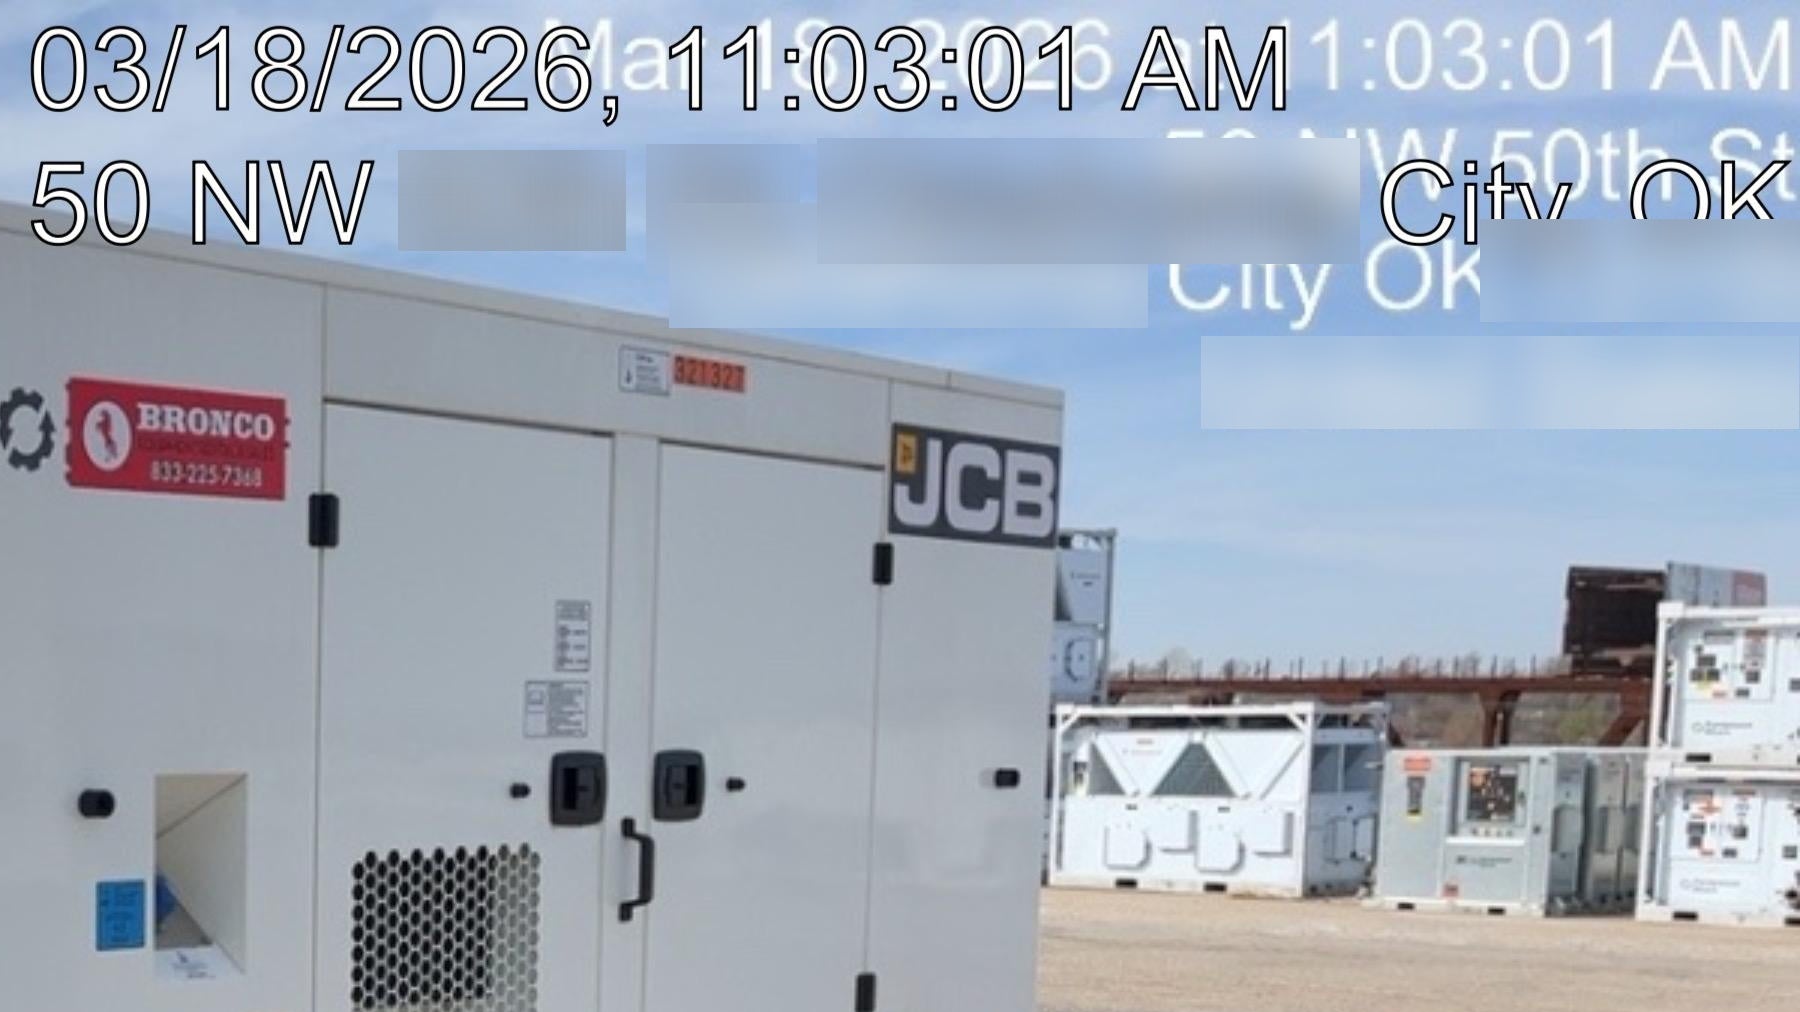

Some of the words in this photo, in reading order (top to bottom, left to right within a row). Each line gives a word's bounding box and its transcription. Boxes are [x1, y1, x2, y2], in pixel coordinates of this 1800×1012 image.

[674, 355, 745, 393] 321327
[137, 403, 275, 441] BRONCO
[893, 437, 1055, 538] JCB
